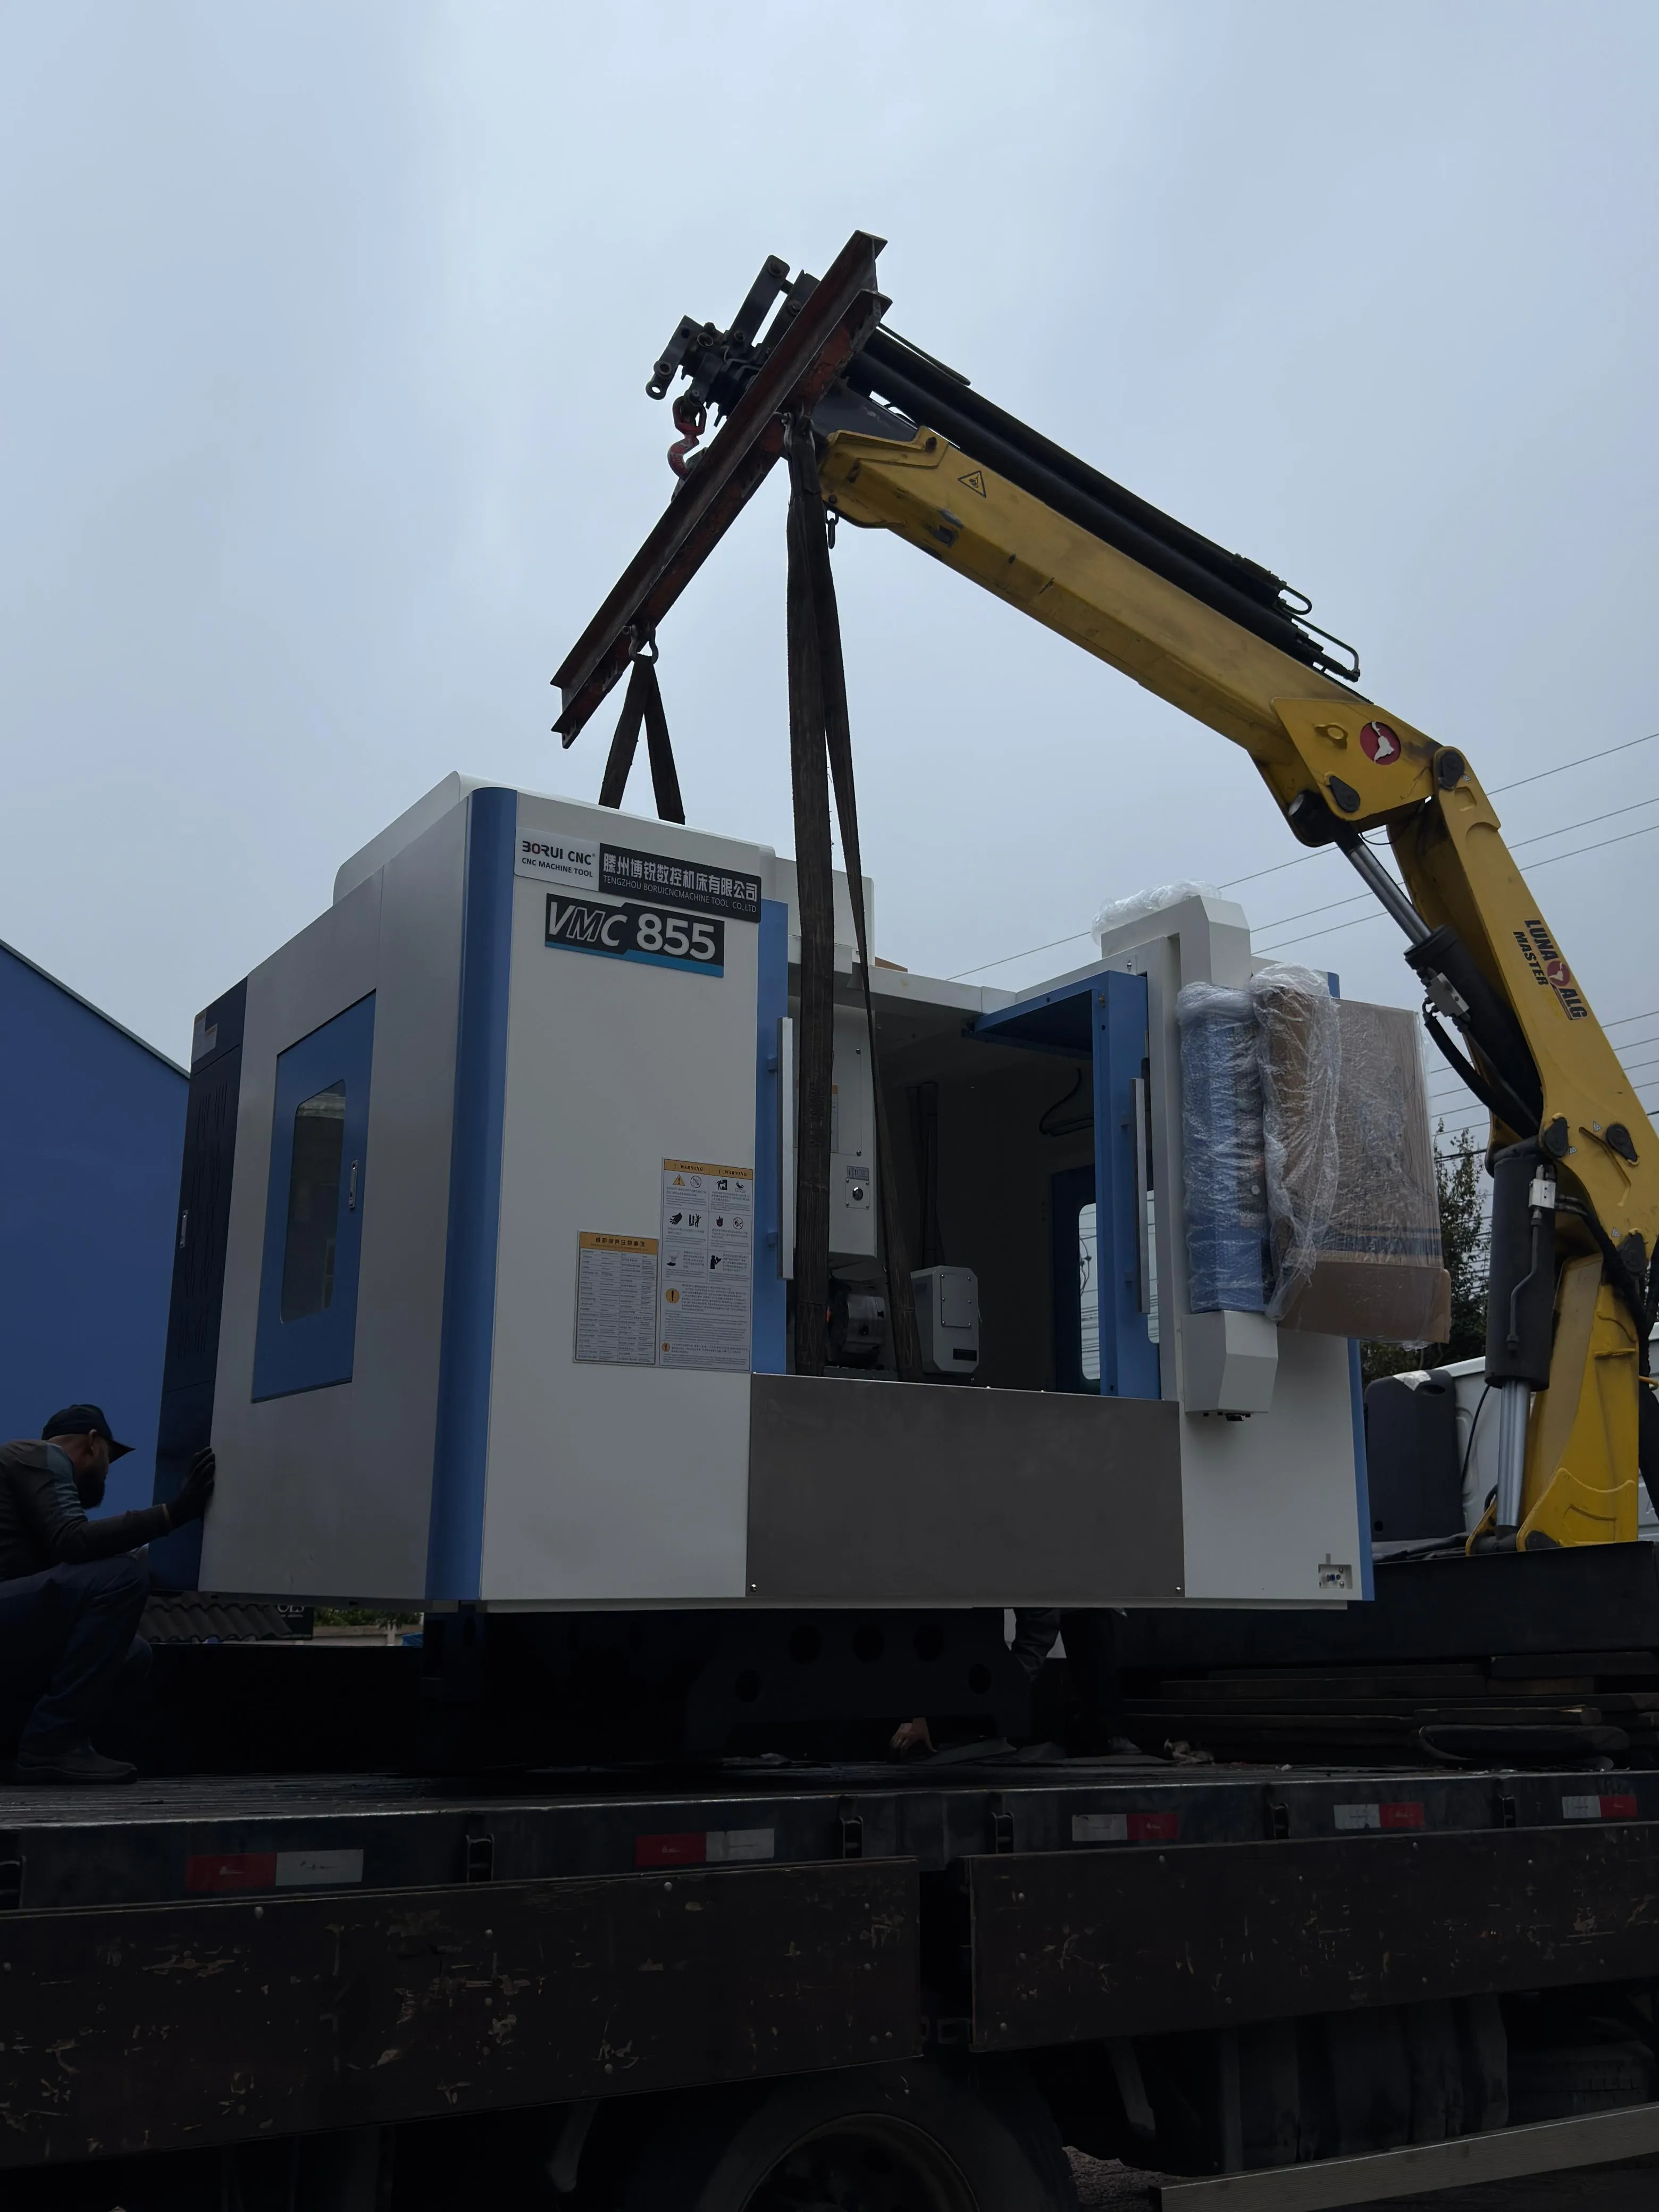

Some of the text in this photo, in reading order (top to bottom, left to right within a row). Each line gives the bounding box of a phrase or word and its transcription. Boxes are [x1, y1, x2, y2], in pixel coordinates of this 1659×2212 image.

[522, 840, 563, 860] BORUI
[539, 861, 572, 873] MACHINE
[574, 868, 593, 877] TOOL
[603, 852, 757, 902] 滕州博锐数控机床有限公司
[603, 875, 641, 890] TENGZHOU
[711, 897, 729, 907] TOOL
[549, 901, 715, 960] VMC 855
[1513, 932, 1549, 985] MASTER
[1524, 919, 1588, 1018] LUNA ALG
